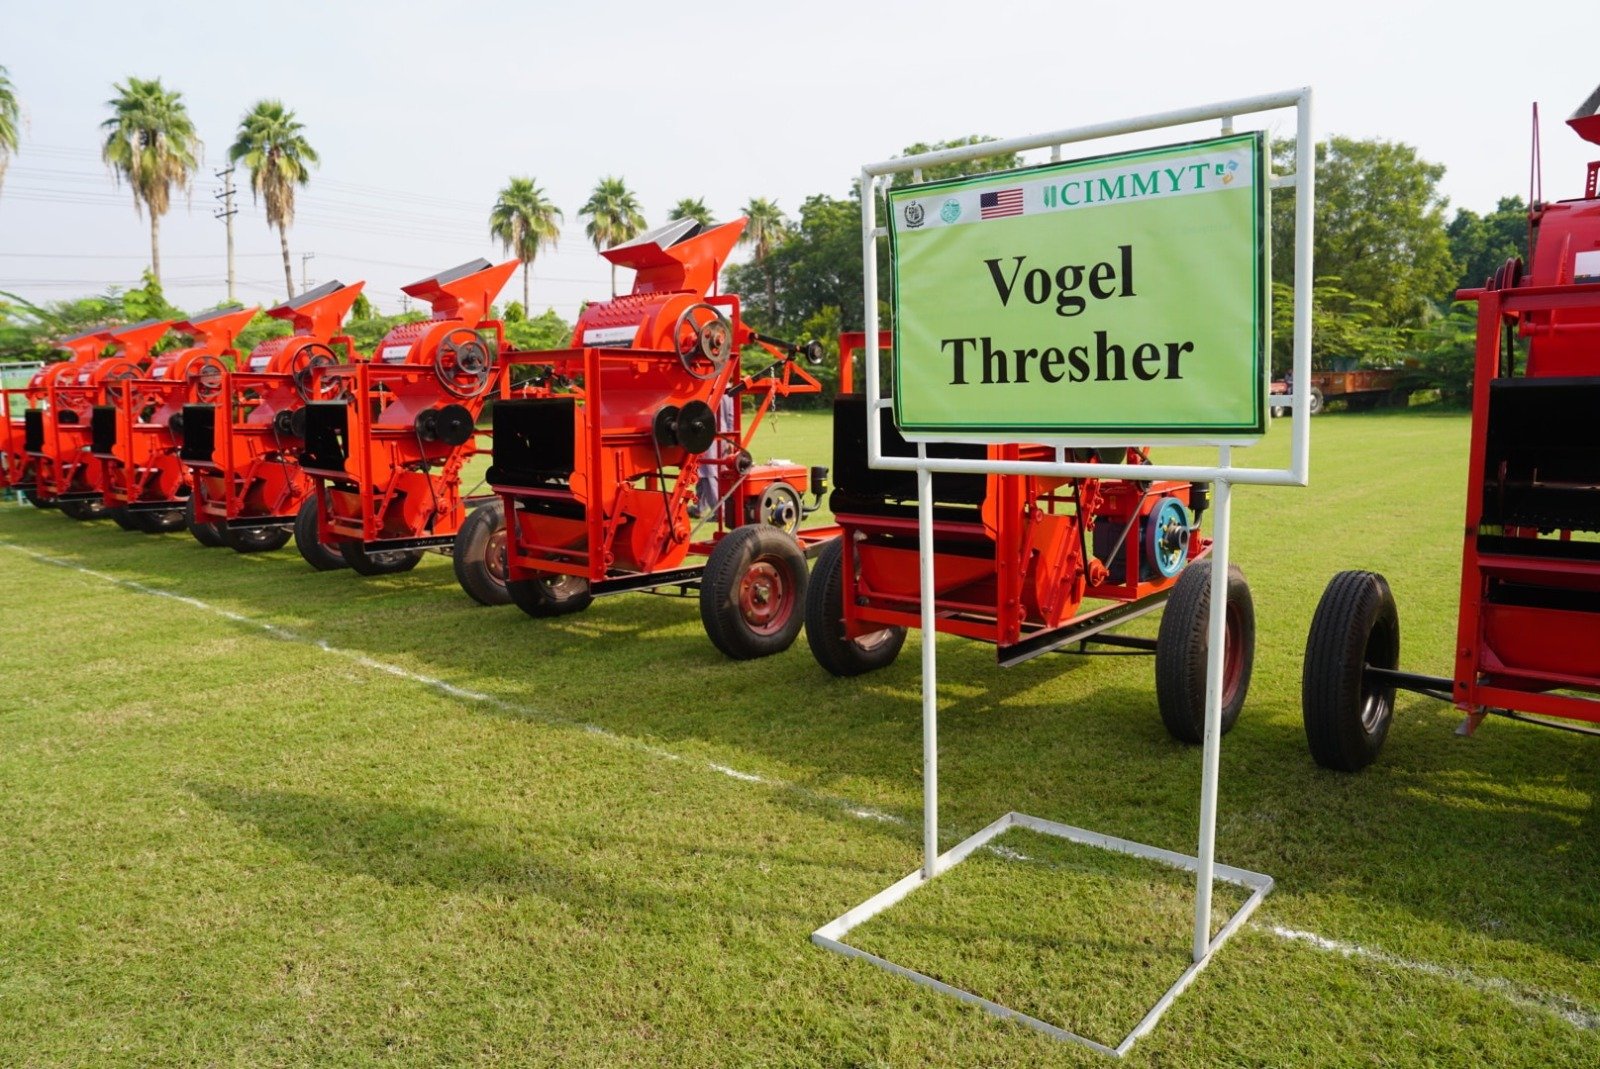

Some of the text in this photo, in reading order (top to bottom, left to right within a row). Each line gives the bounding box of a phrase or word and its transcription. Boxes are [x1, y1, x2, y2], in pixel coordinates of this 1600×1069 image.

[1061, 163, 1210, 206] CIMMYT
[984, 245, 1137, 317] Vogel
[941, 331, 1195, 385] Thresher
